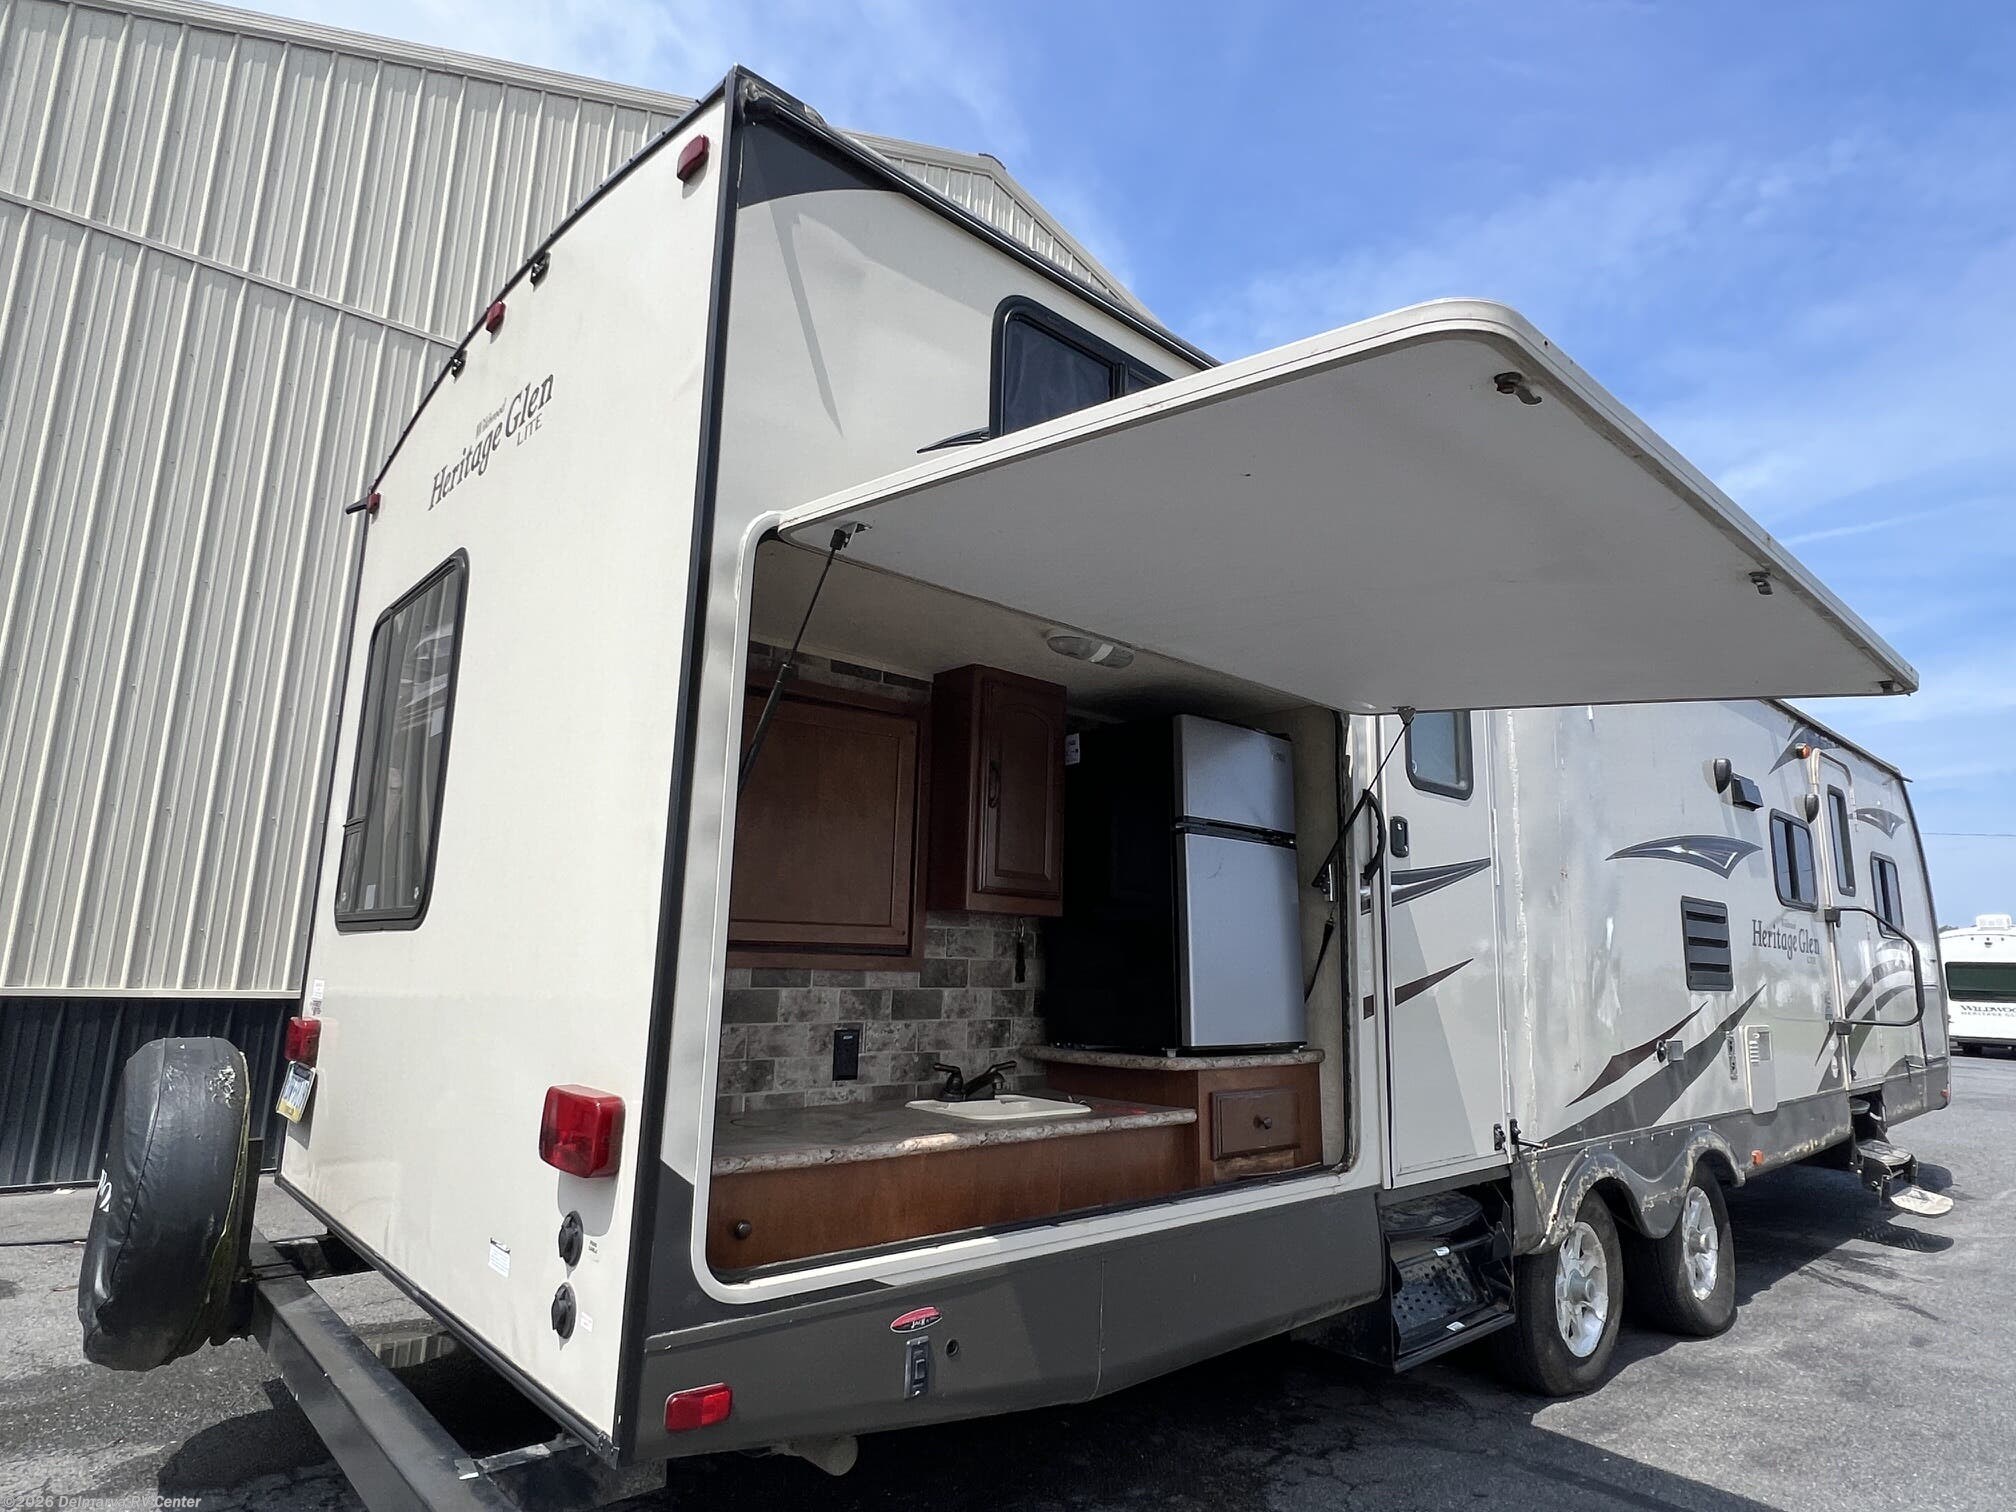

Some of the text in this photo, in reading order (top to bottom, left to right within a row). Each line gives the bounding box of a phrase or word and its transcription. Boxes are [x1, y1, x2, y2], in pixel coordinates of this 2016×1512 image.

[428, 421, 503, 511] Heritage
[505, 374, 554, 438] Glen
[517, 412, 543, 447] LITE
[1752, 919, 1820, 960] Heritage Glen
